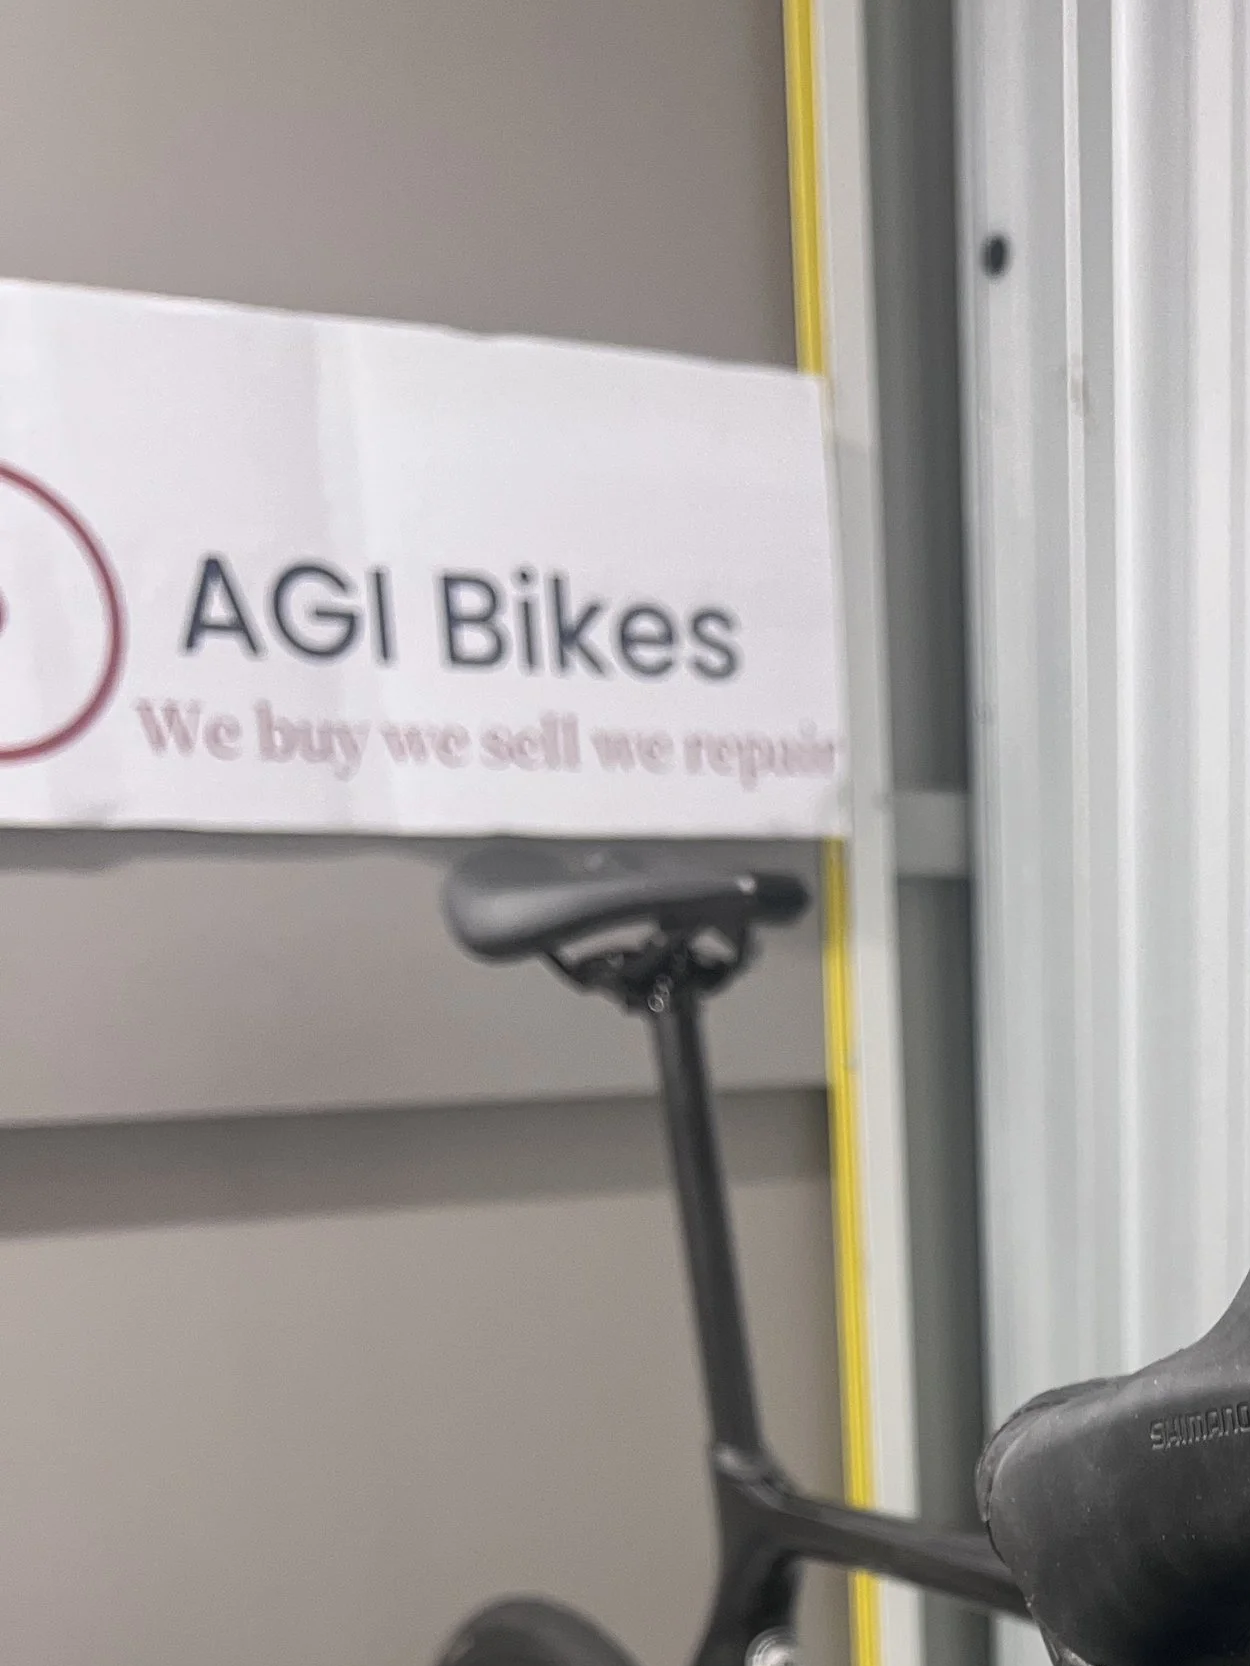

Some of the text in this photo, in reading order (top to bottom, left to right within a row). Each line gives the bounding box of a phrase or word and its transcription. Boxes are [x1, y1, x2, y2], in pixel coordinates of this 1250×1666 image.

[183, 554, 742, 682] AGI Bikes
[135, 699, 243, 761] We
[254, 700, 370, 780] buy
[380, 718, 472, 768] we
[481, 711, 581, 774] sell
[592, 726, 675, 775] we
